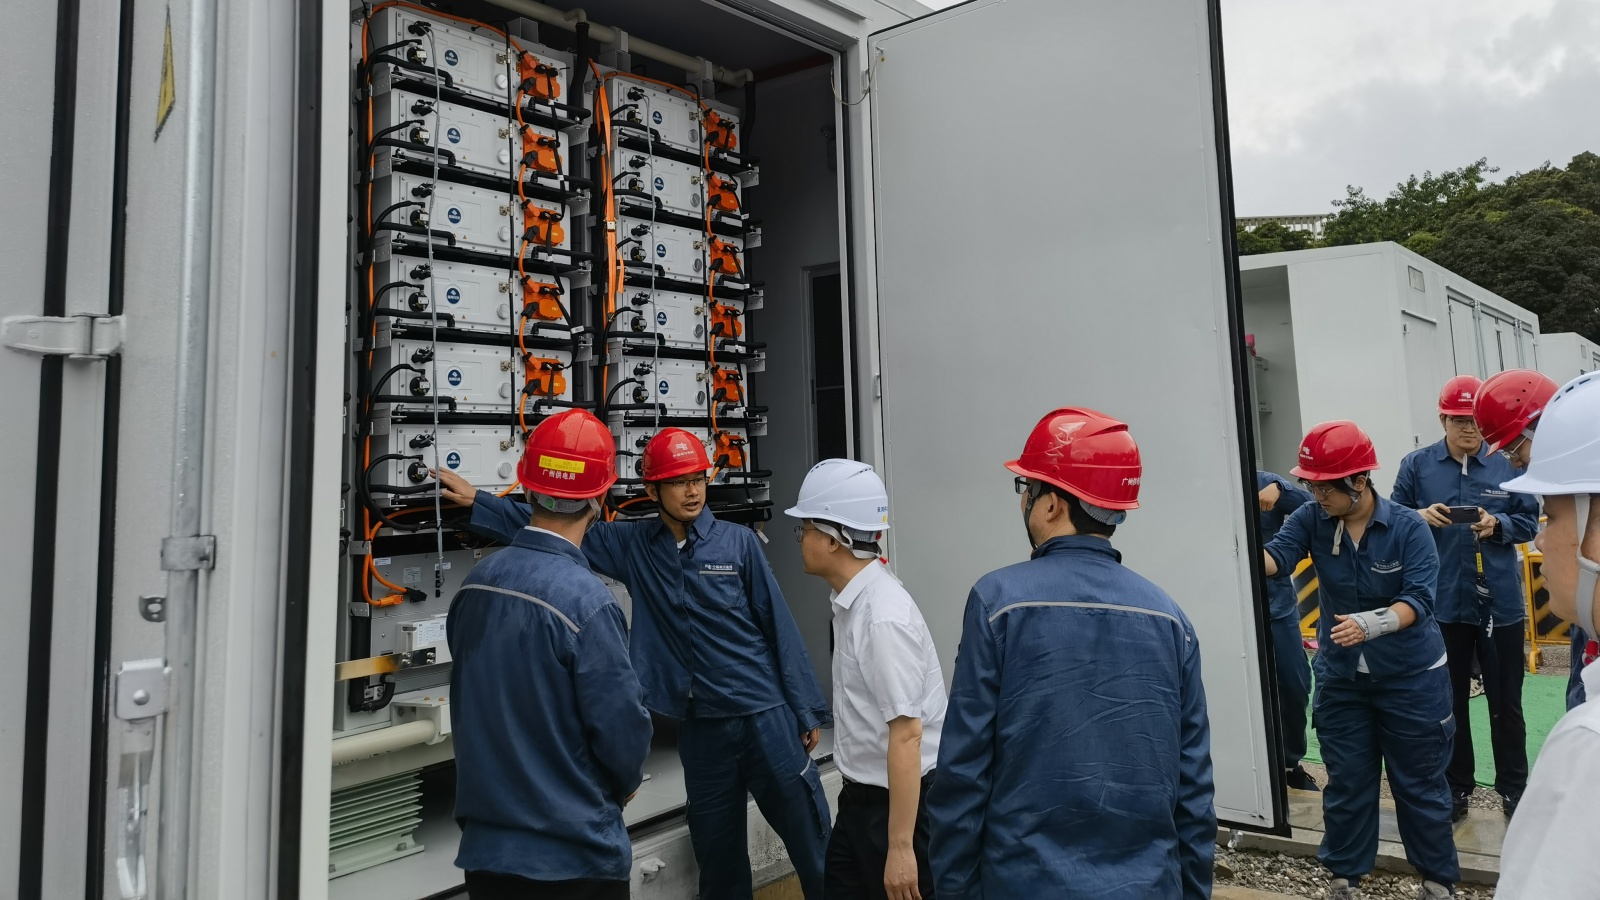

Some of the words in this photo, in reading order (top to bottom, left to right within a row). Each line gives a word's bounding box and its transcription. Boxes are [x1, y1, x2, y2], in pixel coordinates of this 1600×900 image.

[542, 468, 576, 480] 广州供电局
